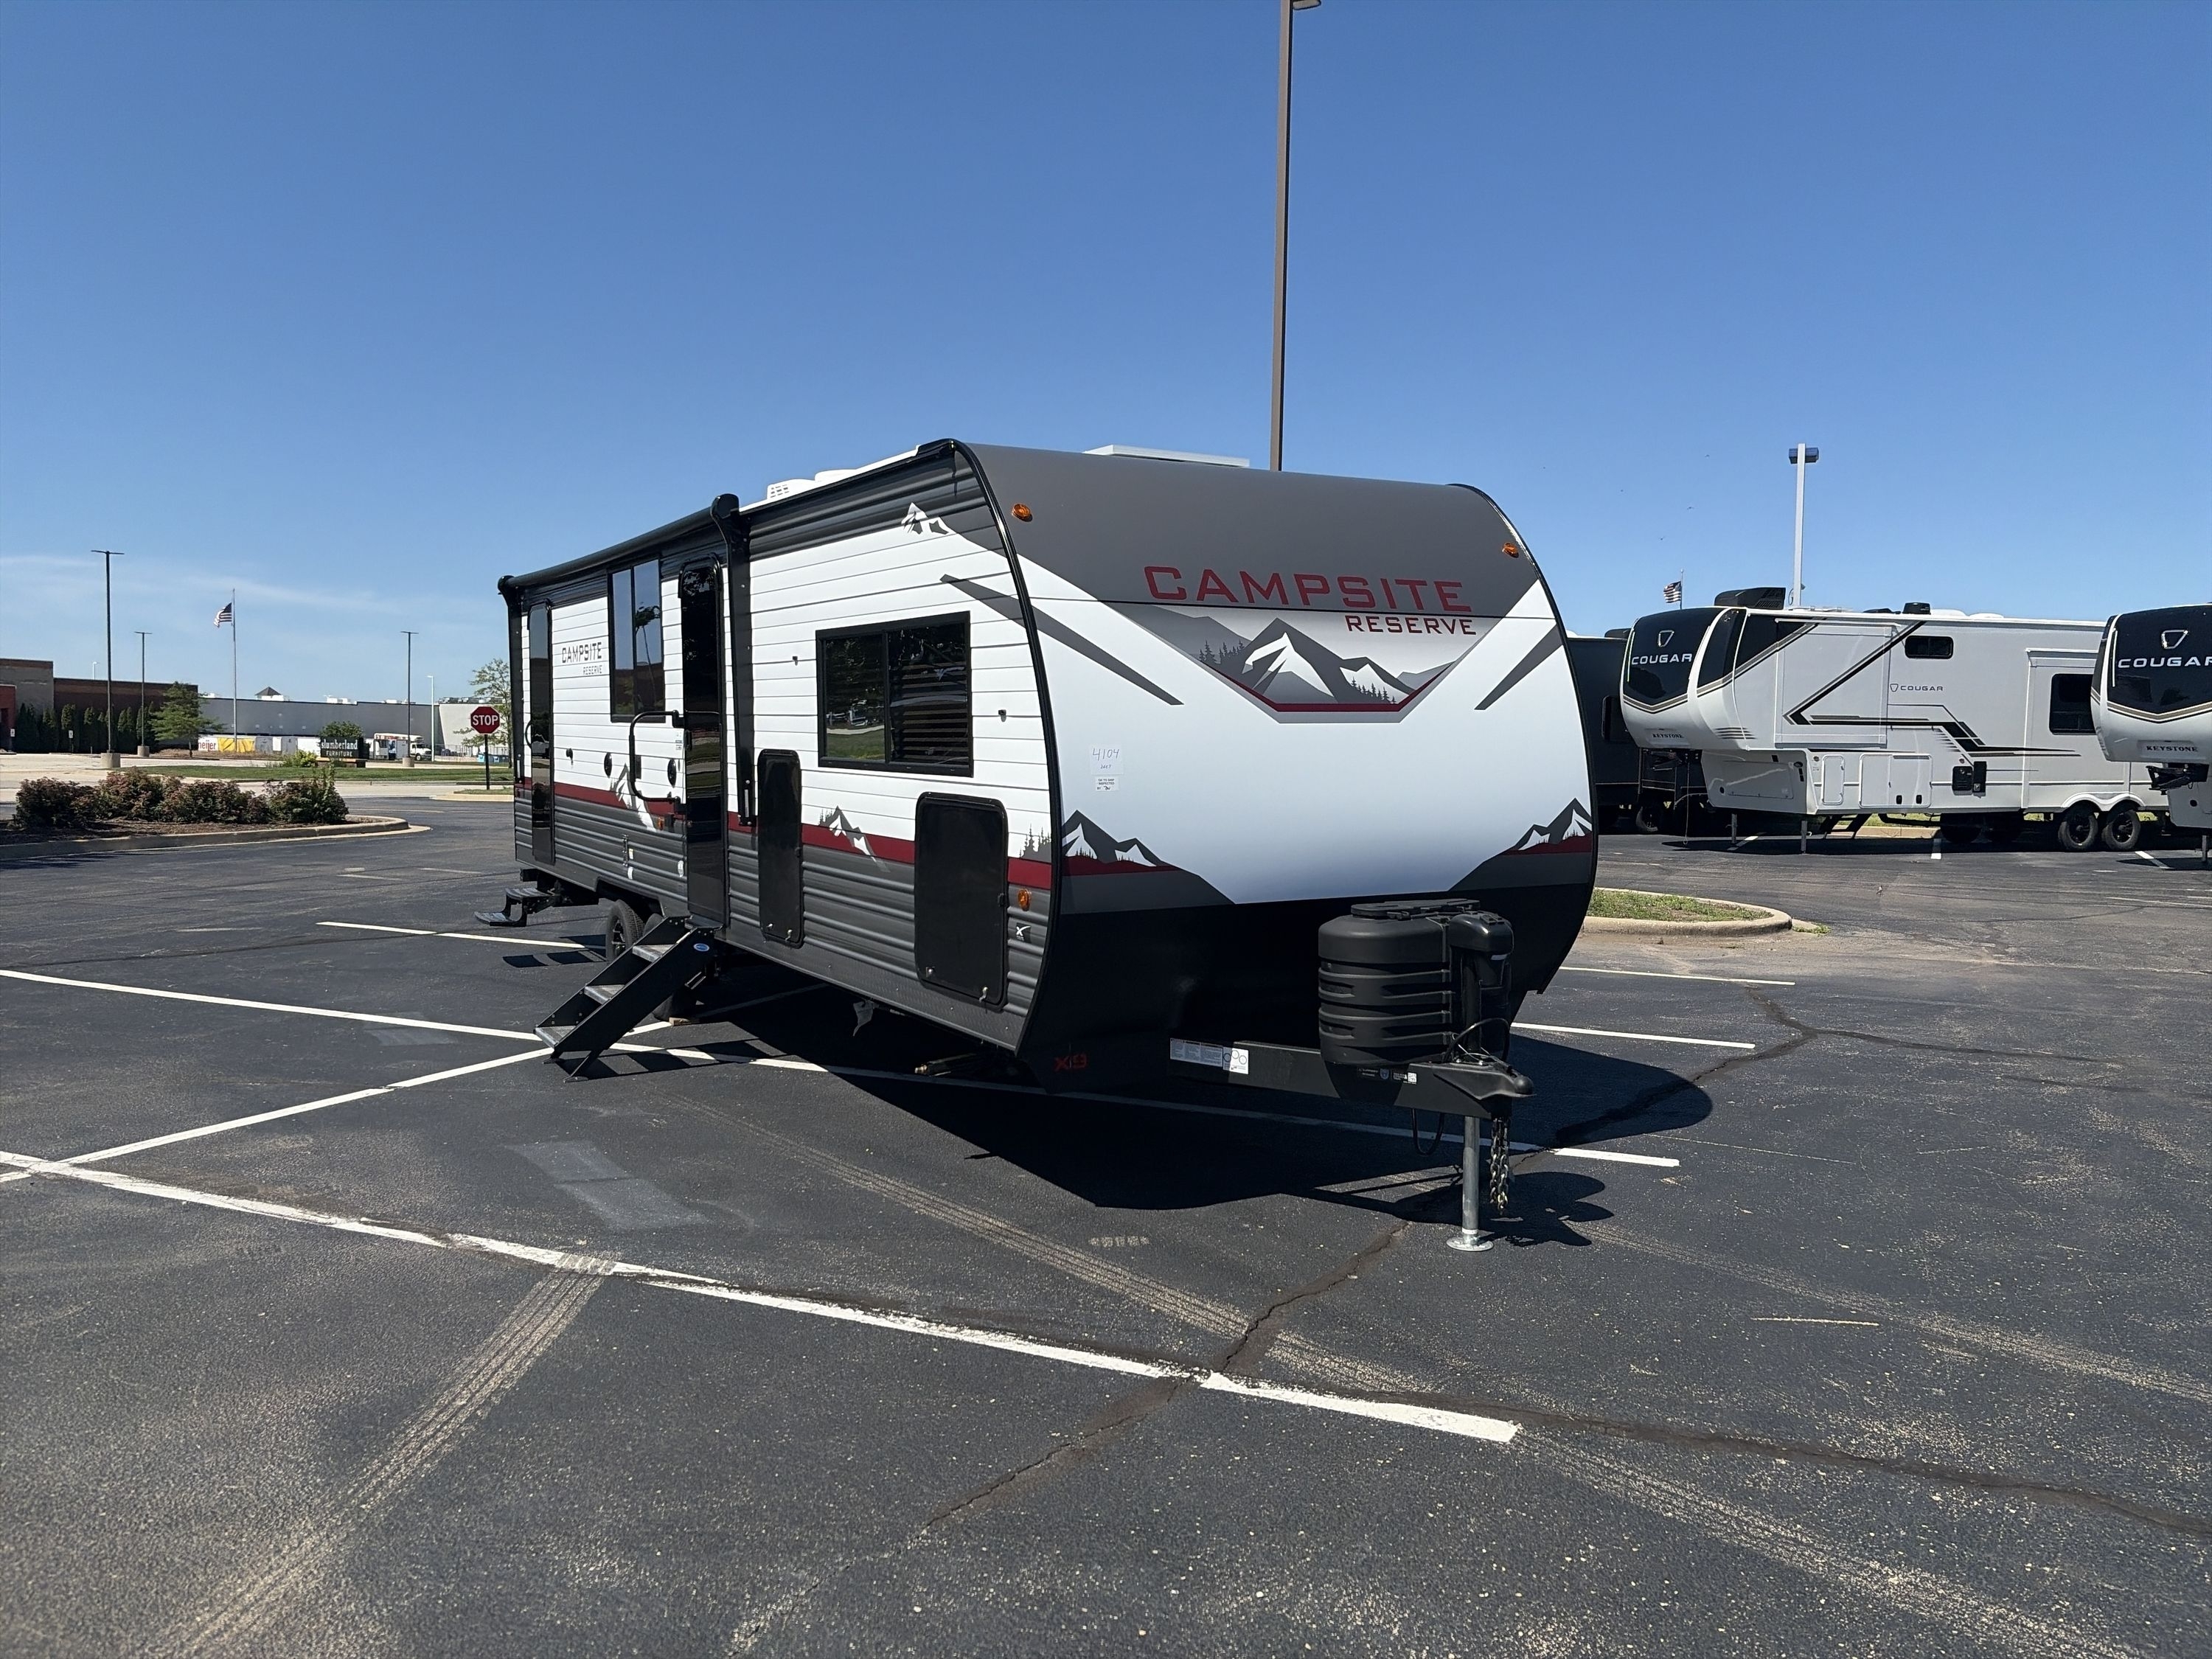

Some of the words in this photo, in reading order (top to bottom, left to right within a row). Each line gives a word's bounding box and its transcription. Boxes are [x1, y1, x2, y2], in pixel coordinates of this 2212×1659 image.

[1144, 566, 1472, 613] CAMPSITE
[1344, 615, 1477, 636] RESERVE
[562, 641, 602, 664] CAMPSITE
[1631, 653, 1693, 665] COUGAR
[582, 665, 602, 675] RESERVE
[472, 714, 498, 726] STOP
[321, 739, 358, 750] slumberland
[1093, 748, 1119, 761] 4104
